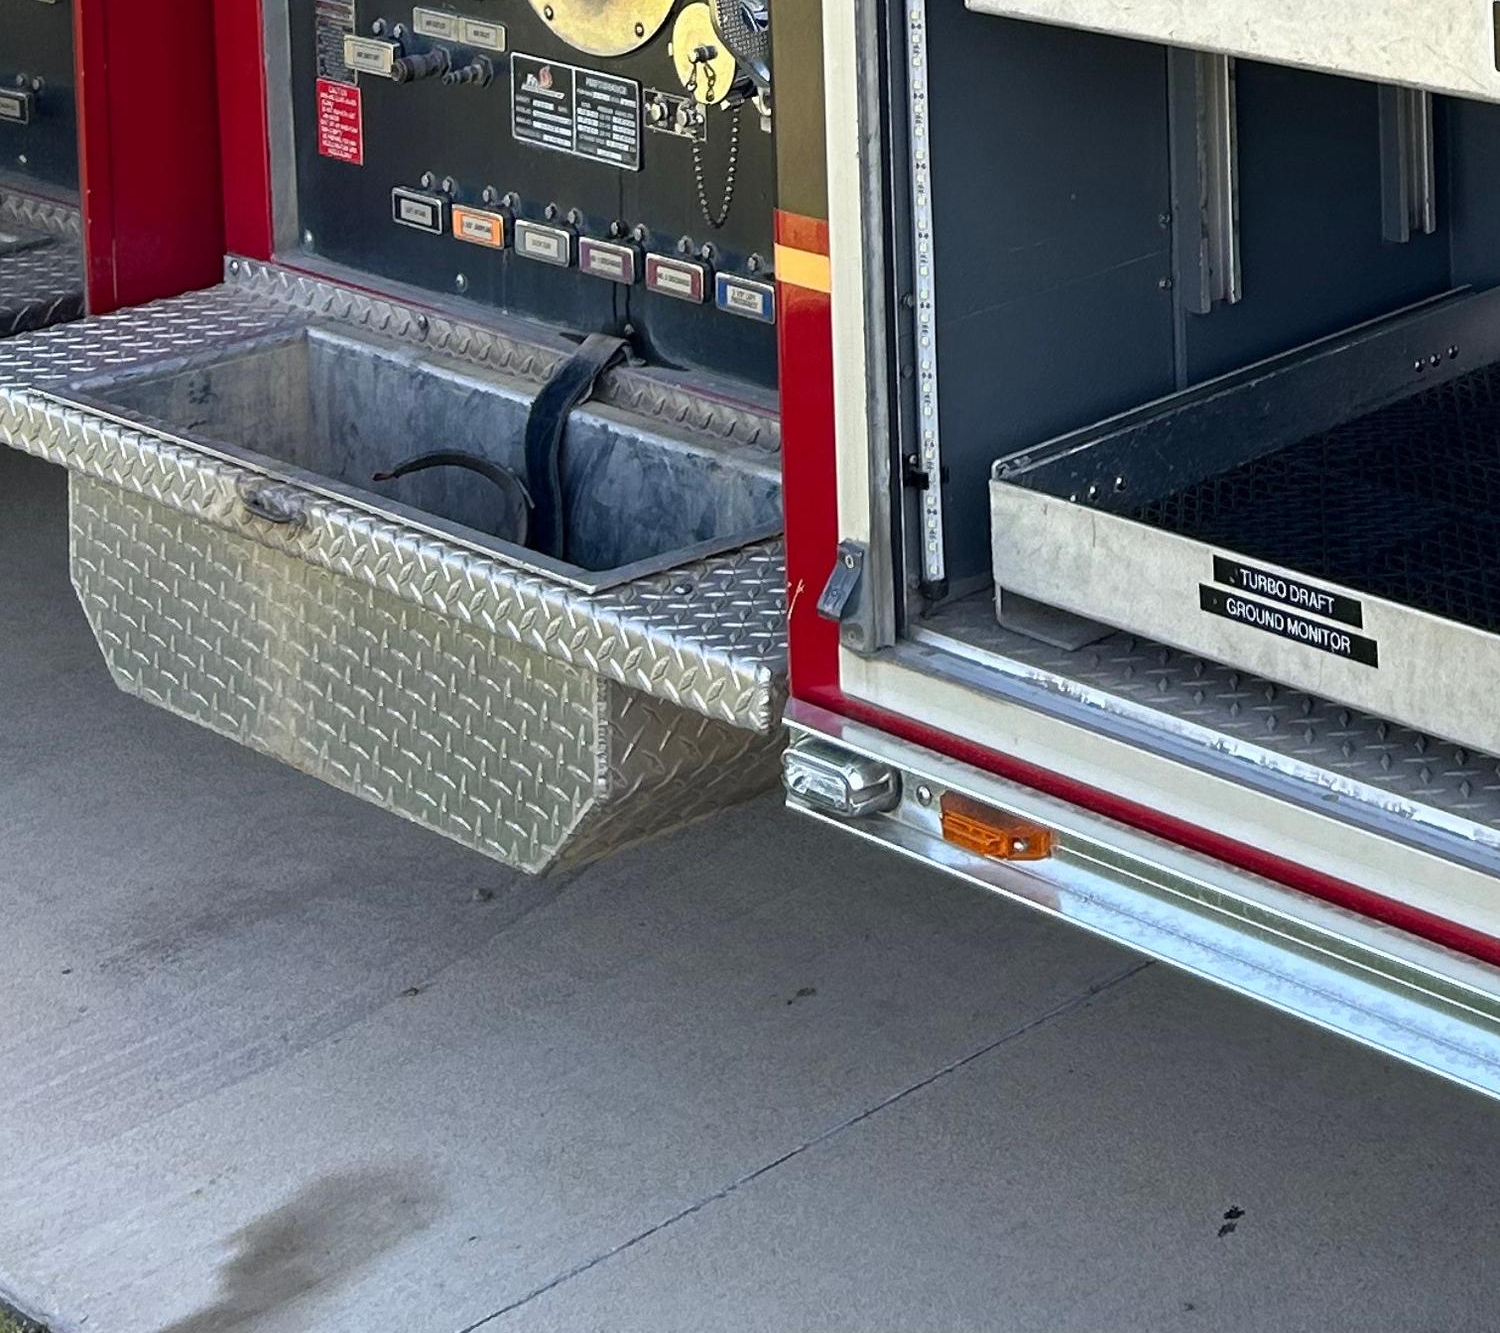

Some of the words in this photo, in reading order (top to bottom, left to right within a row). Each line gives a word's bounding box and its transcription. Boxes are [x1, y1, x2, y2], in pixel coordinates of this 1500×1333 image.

[1240, 569, 1287, 600] TURBO
[1289, 584, 1335, 614] DRAFT
[1226, 597, 1284, 631] GROUND
[1286, 617, 1351, 654] MONITOR
